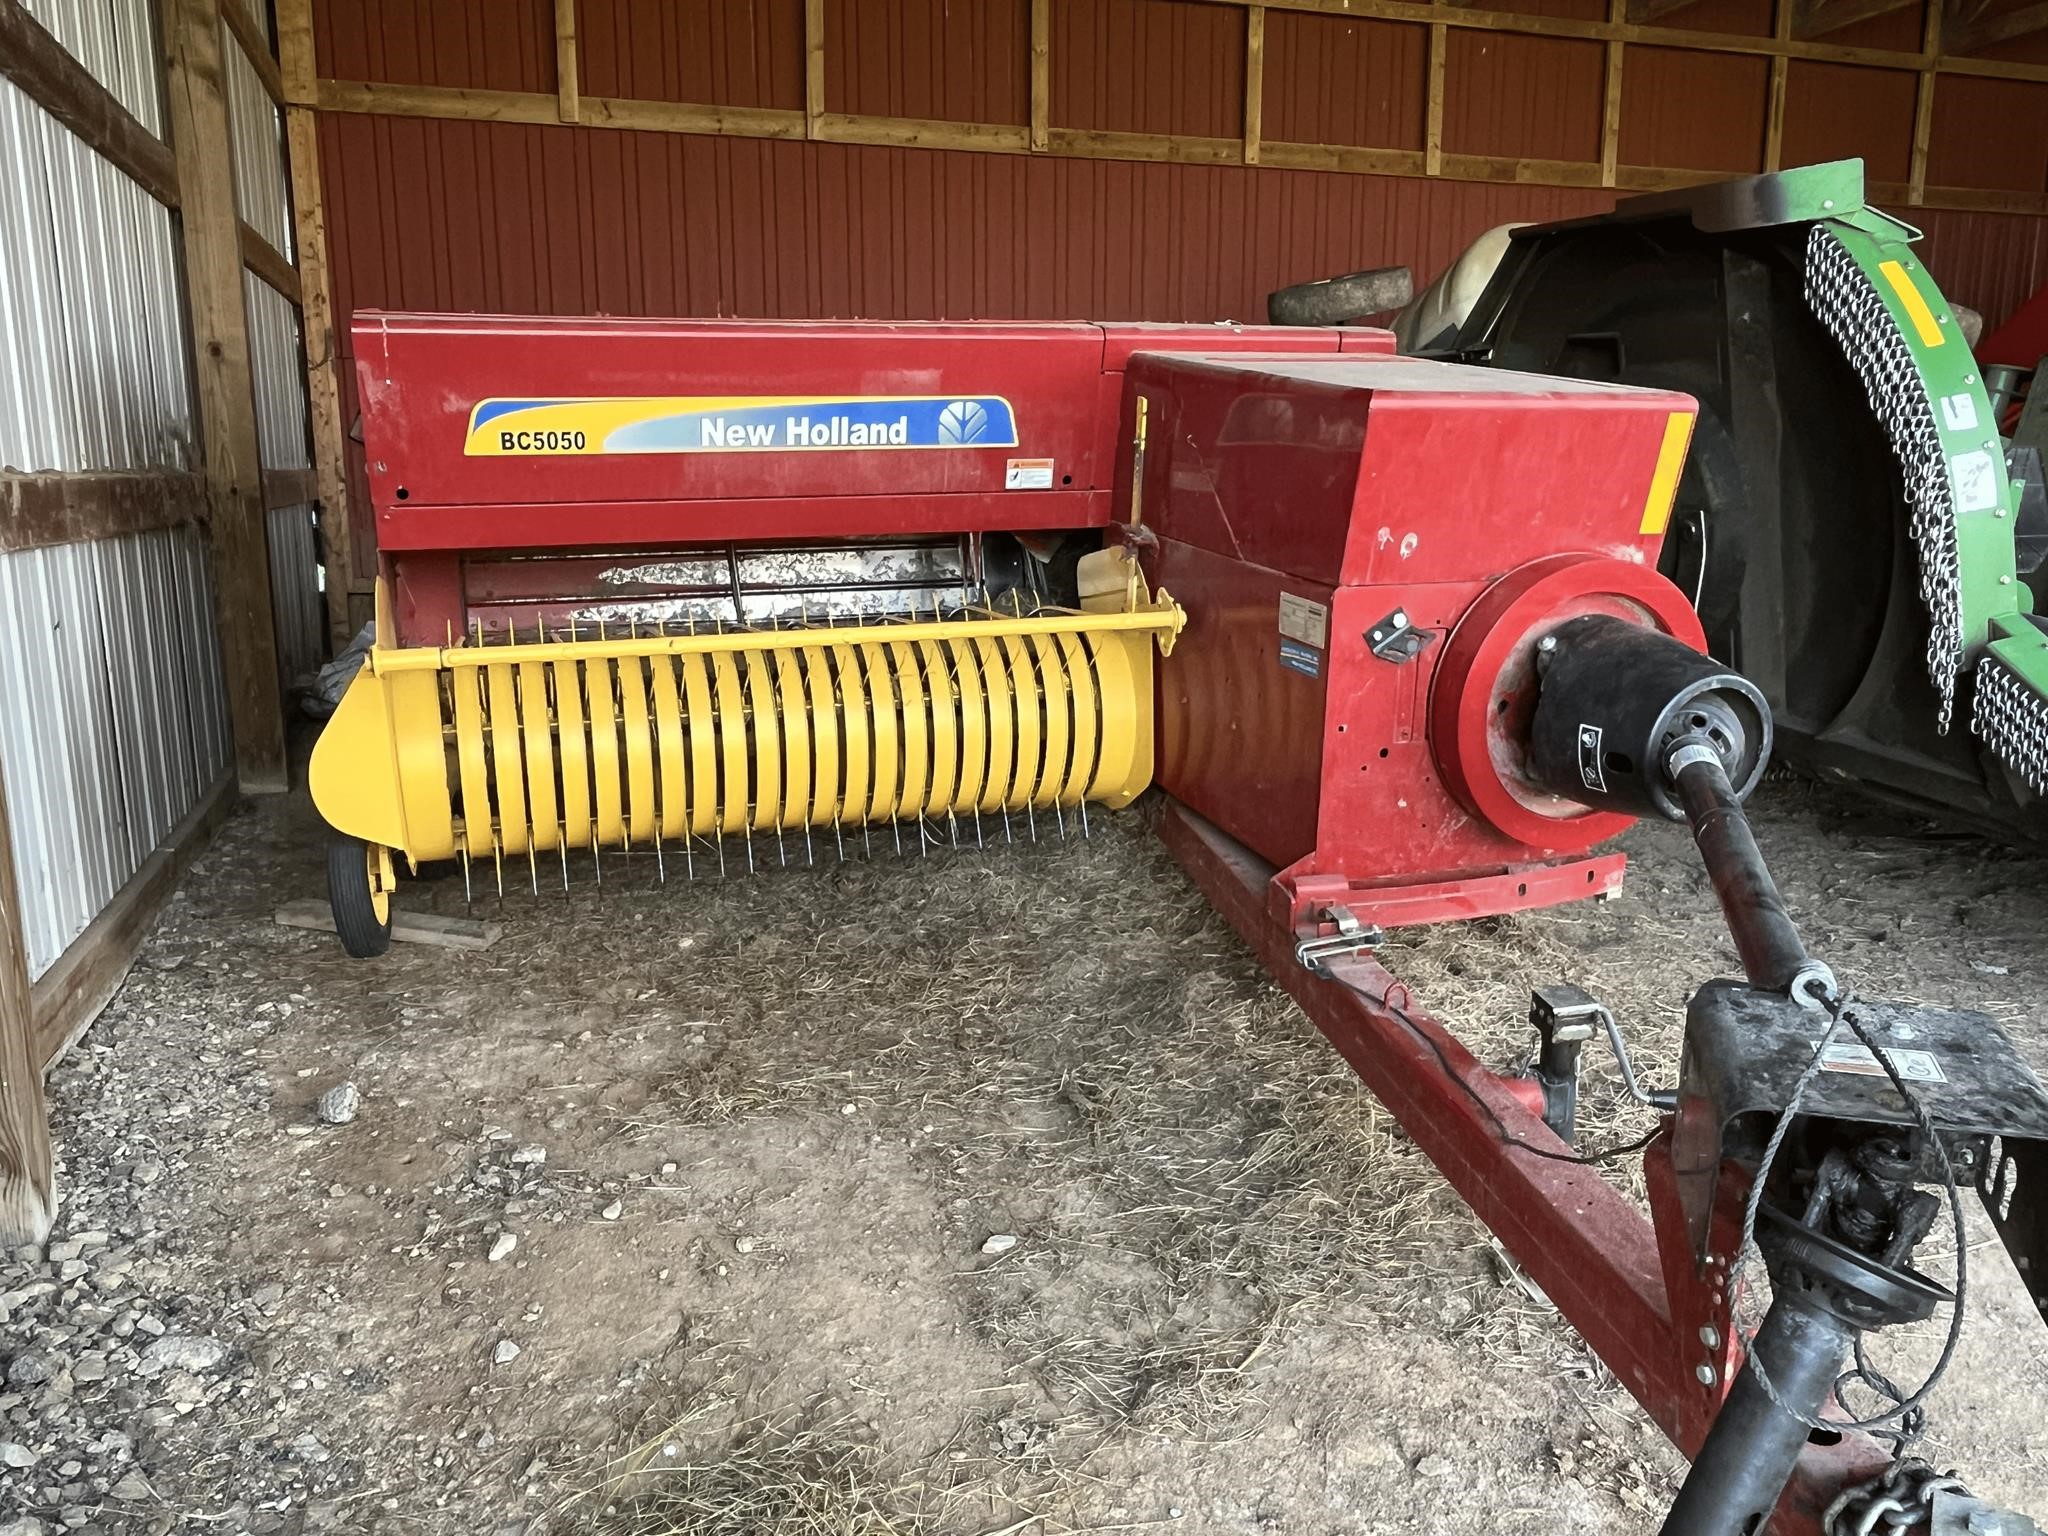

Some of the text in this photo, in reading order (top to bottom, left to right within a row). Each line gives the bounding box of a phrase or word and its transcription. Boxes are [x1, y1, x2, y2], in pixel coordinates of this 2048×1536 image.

[501, 431, 585, 450] BC5050
[701, 415, 908, 446] New Holland
